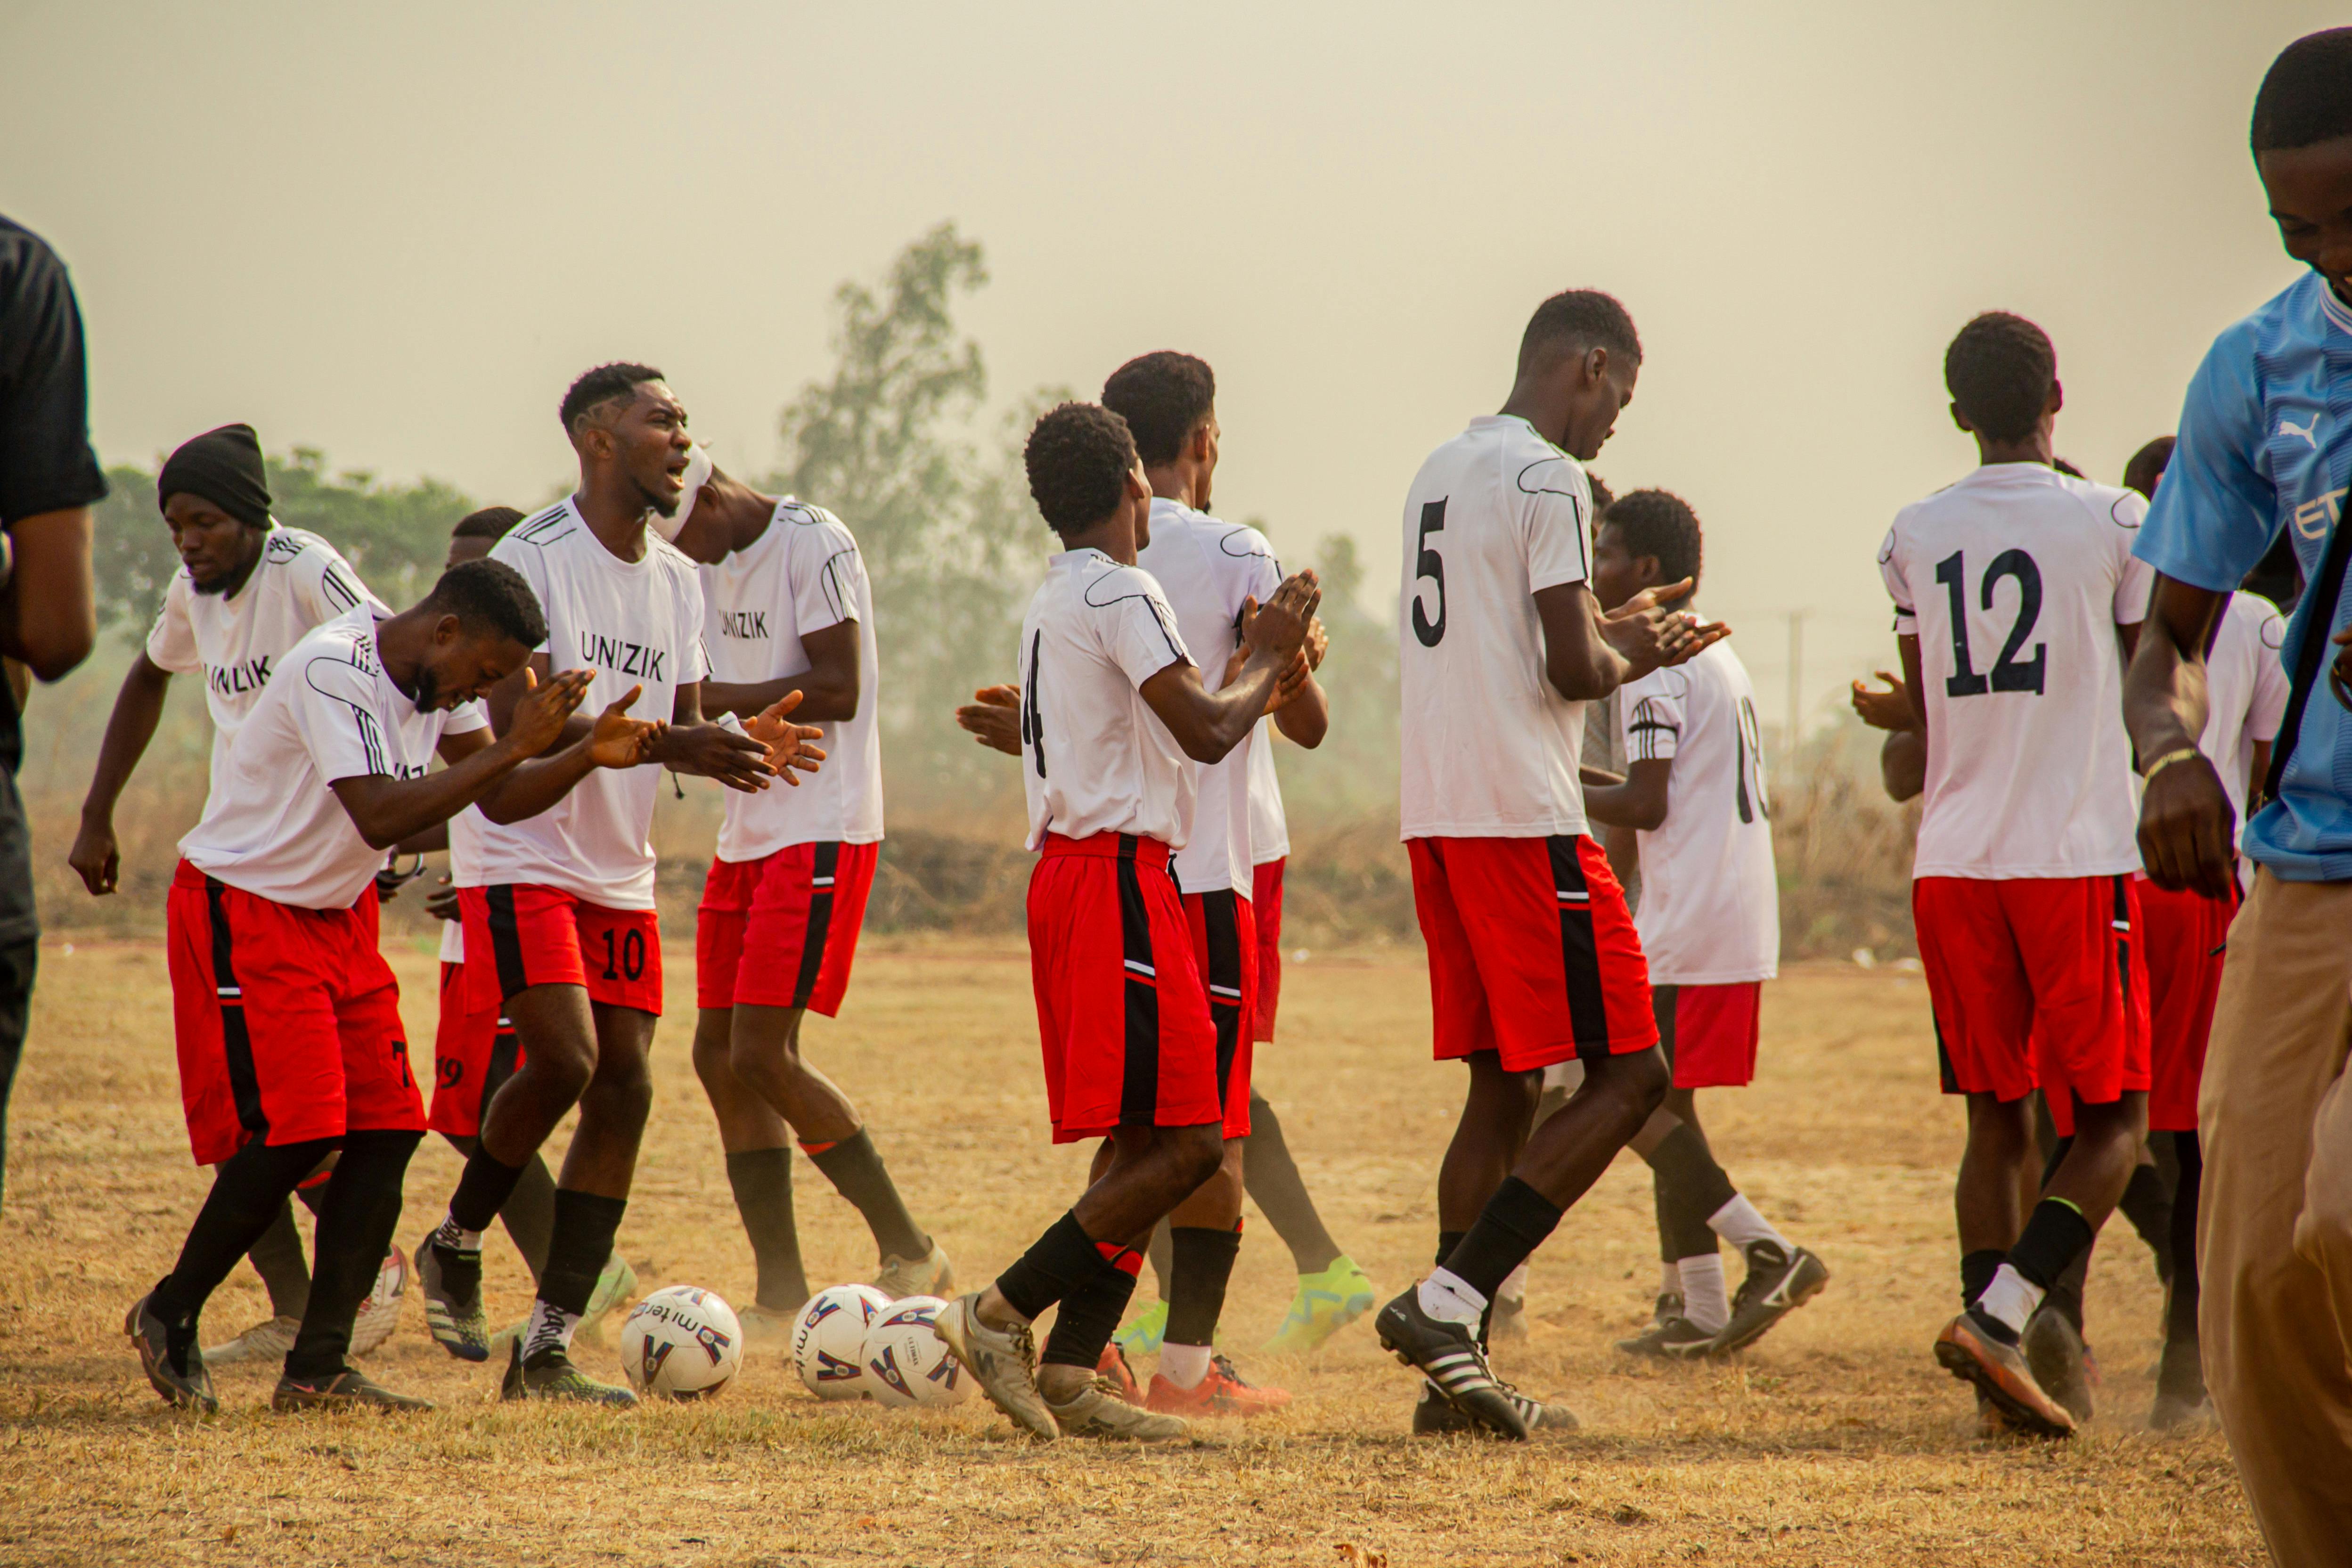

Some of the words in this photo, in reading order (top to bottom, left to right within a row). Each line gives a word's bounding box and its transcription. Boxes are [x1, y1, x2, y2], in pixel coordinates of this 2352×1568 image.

[1412, 495, 1449, 648] 5
[718, 609, 769, 639] UNIZIK
[1936, 548, 2047, 697] 12
[582, 630, 665, 683] UNIZIK
[603, 928, 645, 981] 10
[391, 1039, 410, 1088] 7
